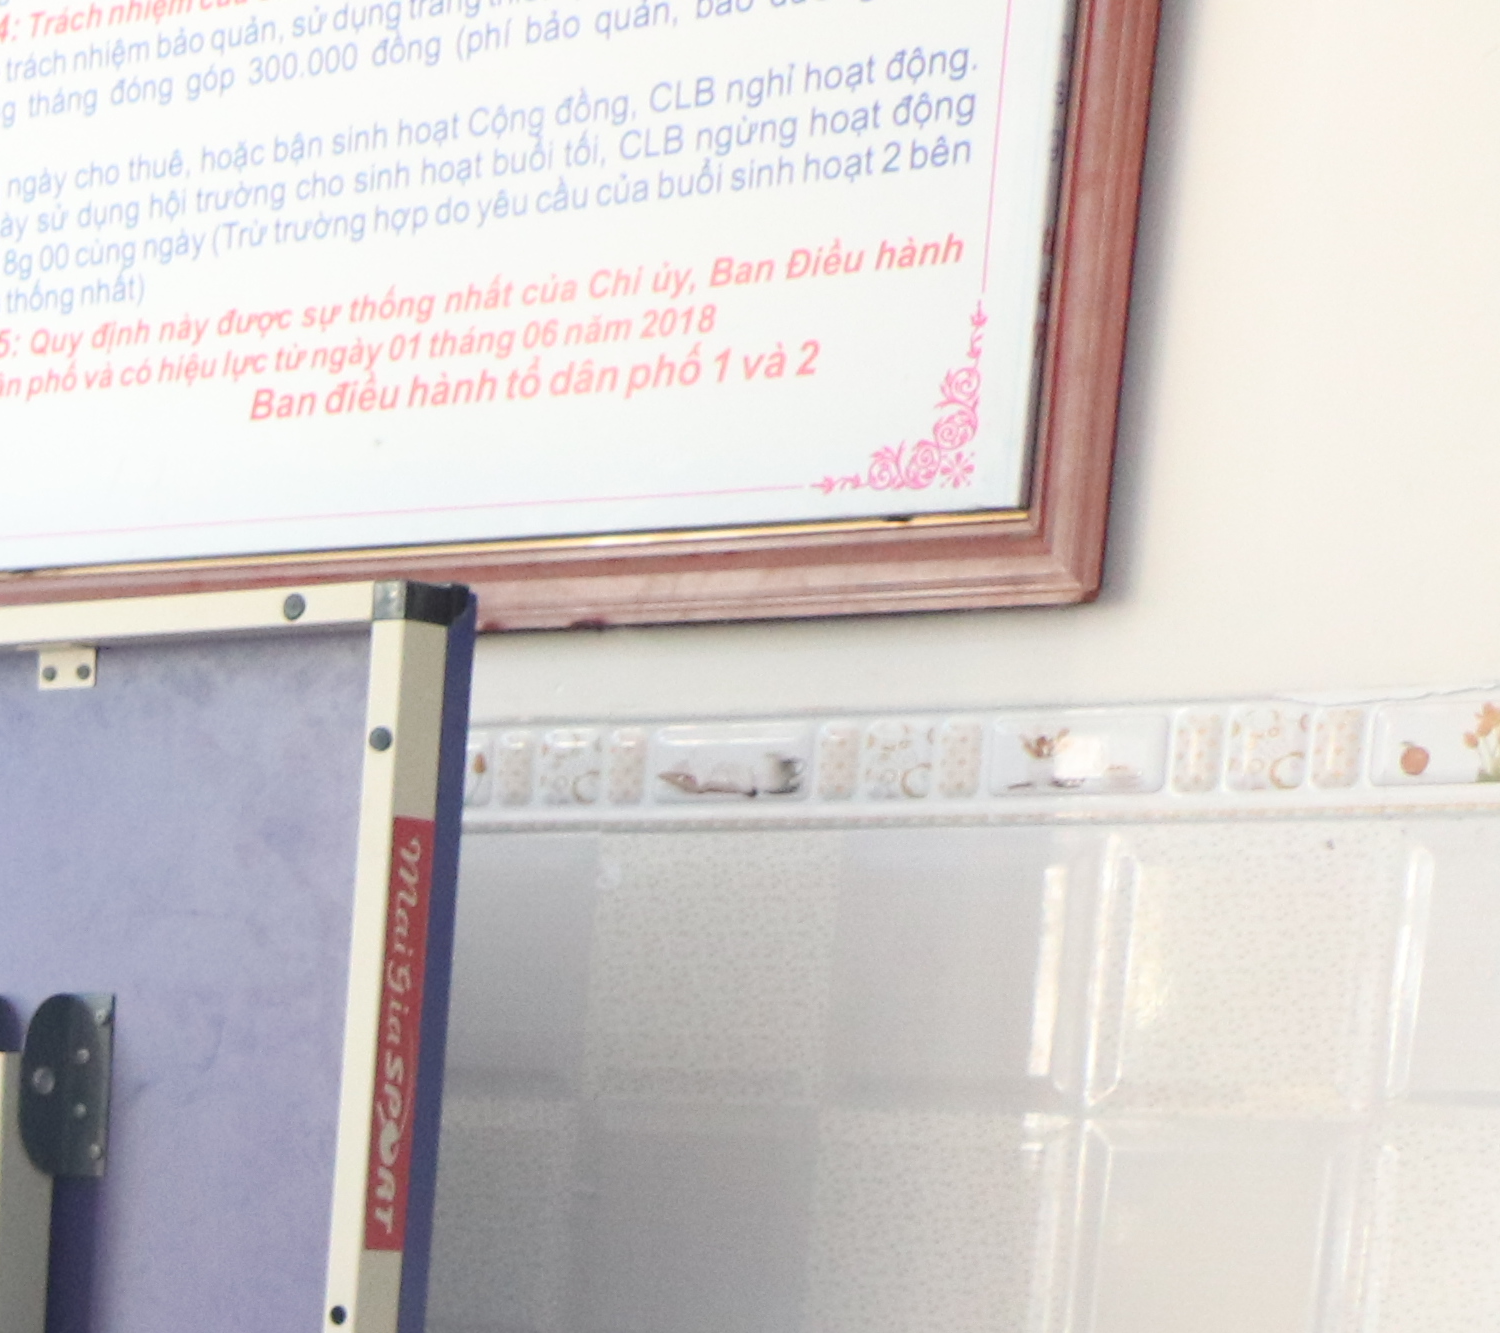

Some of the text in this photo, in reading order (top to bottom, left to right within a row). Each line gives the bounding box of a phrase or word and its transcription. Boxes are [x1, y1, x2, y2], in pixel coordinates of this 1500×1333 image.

[28, 88, 97, 117] tháng
[110, 76, 172, 105] đóng
[186, 64, 234, 101] góp
[249, 42, 357, 84] 300.000
[371, 31, 441, 67] đồng
[456, 18, 511, 60] (phí
[525, 9, 580, 44] bảo
[7, 168, 66, 203] ngày
[74, 161, 119, 189] cho
[331, 123, 387, 155] sinh
[397, 113, 459, 146] hoạt
[468, 104, 544, 138] Cộng
[555, 88, 635, 126] đồng,
[649, 75, 715, 113] CLB
[803, 55, 875, 93] hoạt
[885, 46, 976, 84] động.
[77, 200, 139, 229] dụng
[149, 189, 186, 221] hội
[196, 181, 285, 212] trường
[295, 172, 344, 200] cho
[354, 161, 409, 193] sinh
[420, 152, 482, 185] hoạt
[619, 123, 683, 160] CLB
[809, 100, 880, 136] hoạt
[892, 91, 976, 129] động
[29, 327, 83, 359] Quy
[90, 319, 150, 353] định
[157, 313, 209, 346] này
[215, 308, 292, 337] được
[300, 304, 342, 332] sự
[348, 286, 435, 324] thống
[443, 274, 513, 313] nhất
[520, 273, 577, 306] của
[708, 256, 775, 288] Ban
[785, 238, 864, 280] Điều
[874, 233, 963, 270] hành
[83, 362, 113, 390] và
[119, 358, 152, 387] có
[157, 352, 216, 386] hiệu
[310, 337, 383, 375] ngày
[387, 331, 421, 362] 01
[428, 326, 515, 360] tháng
[521, 318, 558, 350] 06
[563, 315, 632, 345] năm
[639, 303, 716, 343] 2018
[249, 387, 317, 422] Ban
[323, 374, 400, 415] điều
[407, 369, 497, 407] hành
[548, 359, 619, 397] dân
[713, 347, 732, 384] 1
[742, 341, 787, 381] và
[794, 338, 820, 378] 2
